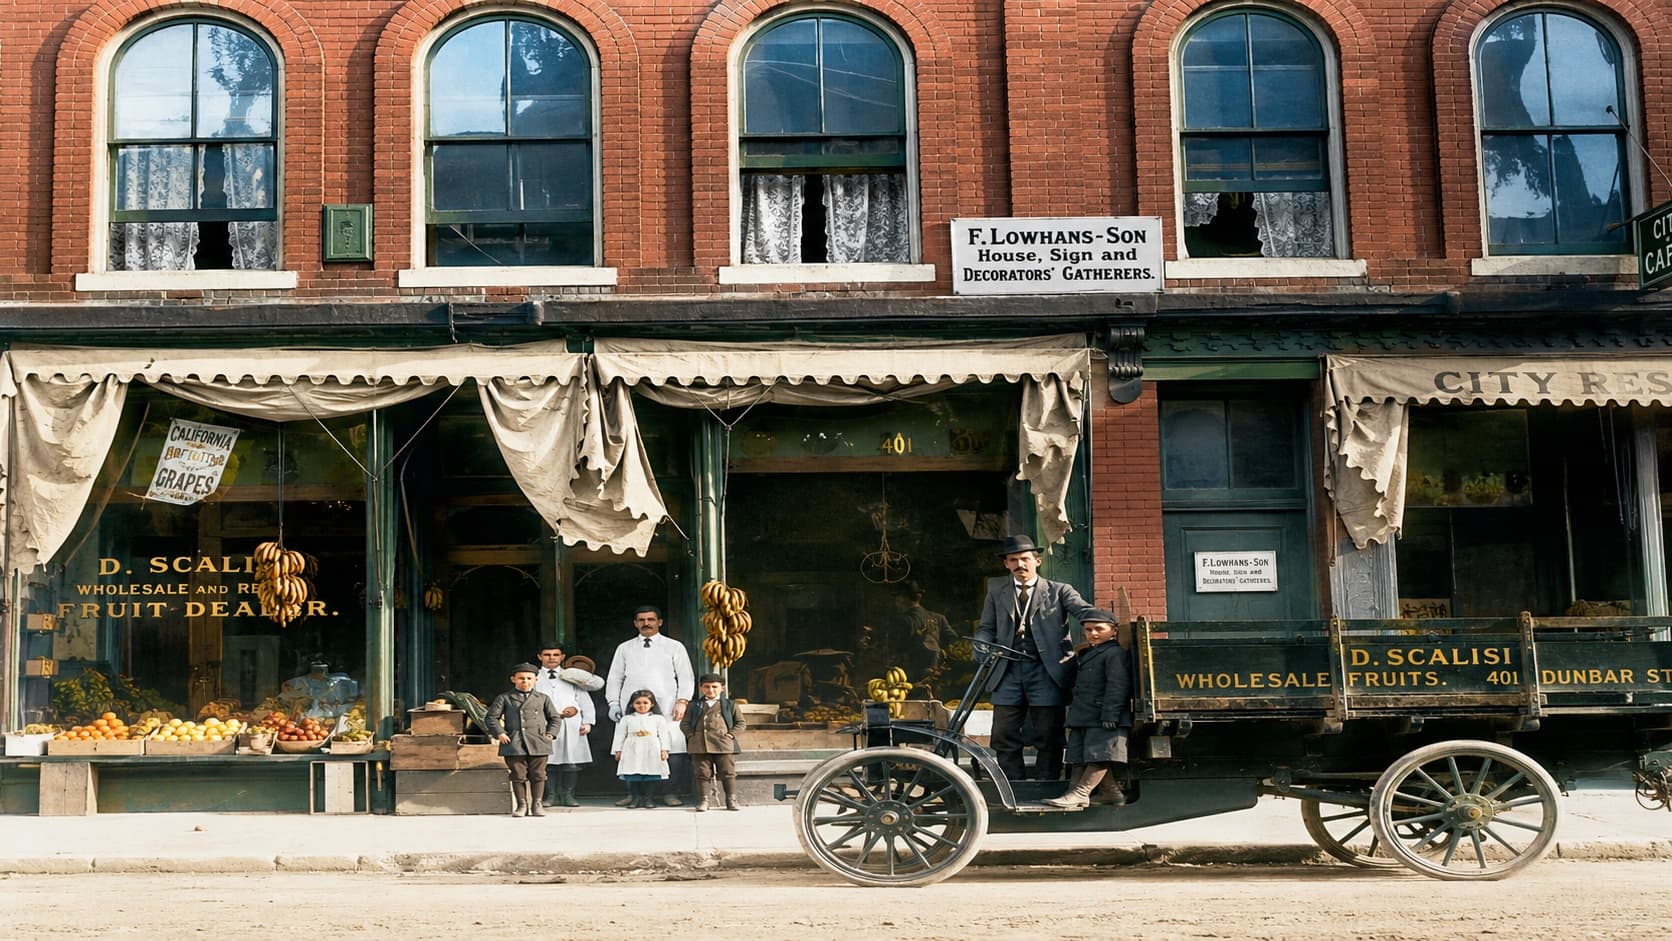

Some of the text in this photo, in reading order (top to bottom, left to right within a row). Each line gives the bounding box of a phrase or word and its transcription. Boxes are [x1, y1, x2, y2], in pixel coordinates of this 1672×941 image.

[978, 248, 1137, 264] House, Sign and
[963, 266, 1155, 282] DECORATORS' GATHERERS.
[1434, 371, 1672, 395] CITY RES
[170, 425, 233, 451] CALIFORNIA
[881, 432, 912, 454] 401
[155, 467, 214, 495] GRAPES
[98, 556, 255, 575] D. SCALI
[77, 583, 189, 596] WHOLESALE
[196, 585, 228, 595] AND
[56, 600, 339, 619] FRUIT DEALR.
[1351, 648, 1512, 666] D. SCALISI
[1176, 672, 1331, 688] WHOLESALE
[1348, 671, 1447, 687] FRUITS.
[1486, 671, 1519, 685] 401
[1541, 668, 1634, 685] DUNBAR
